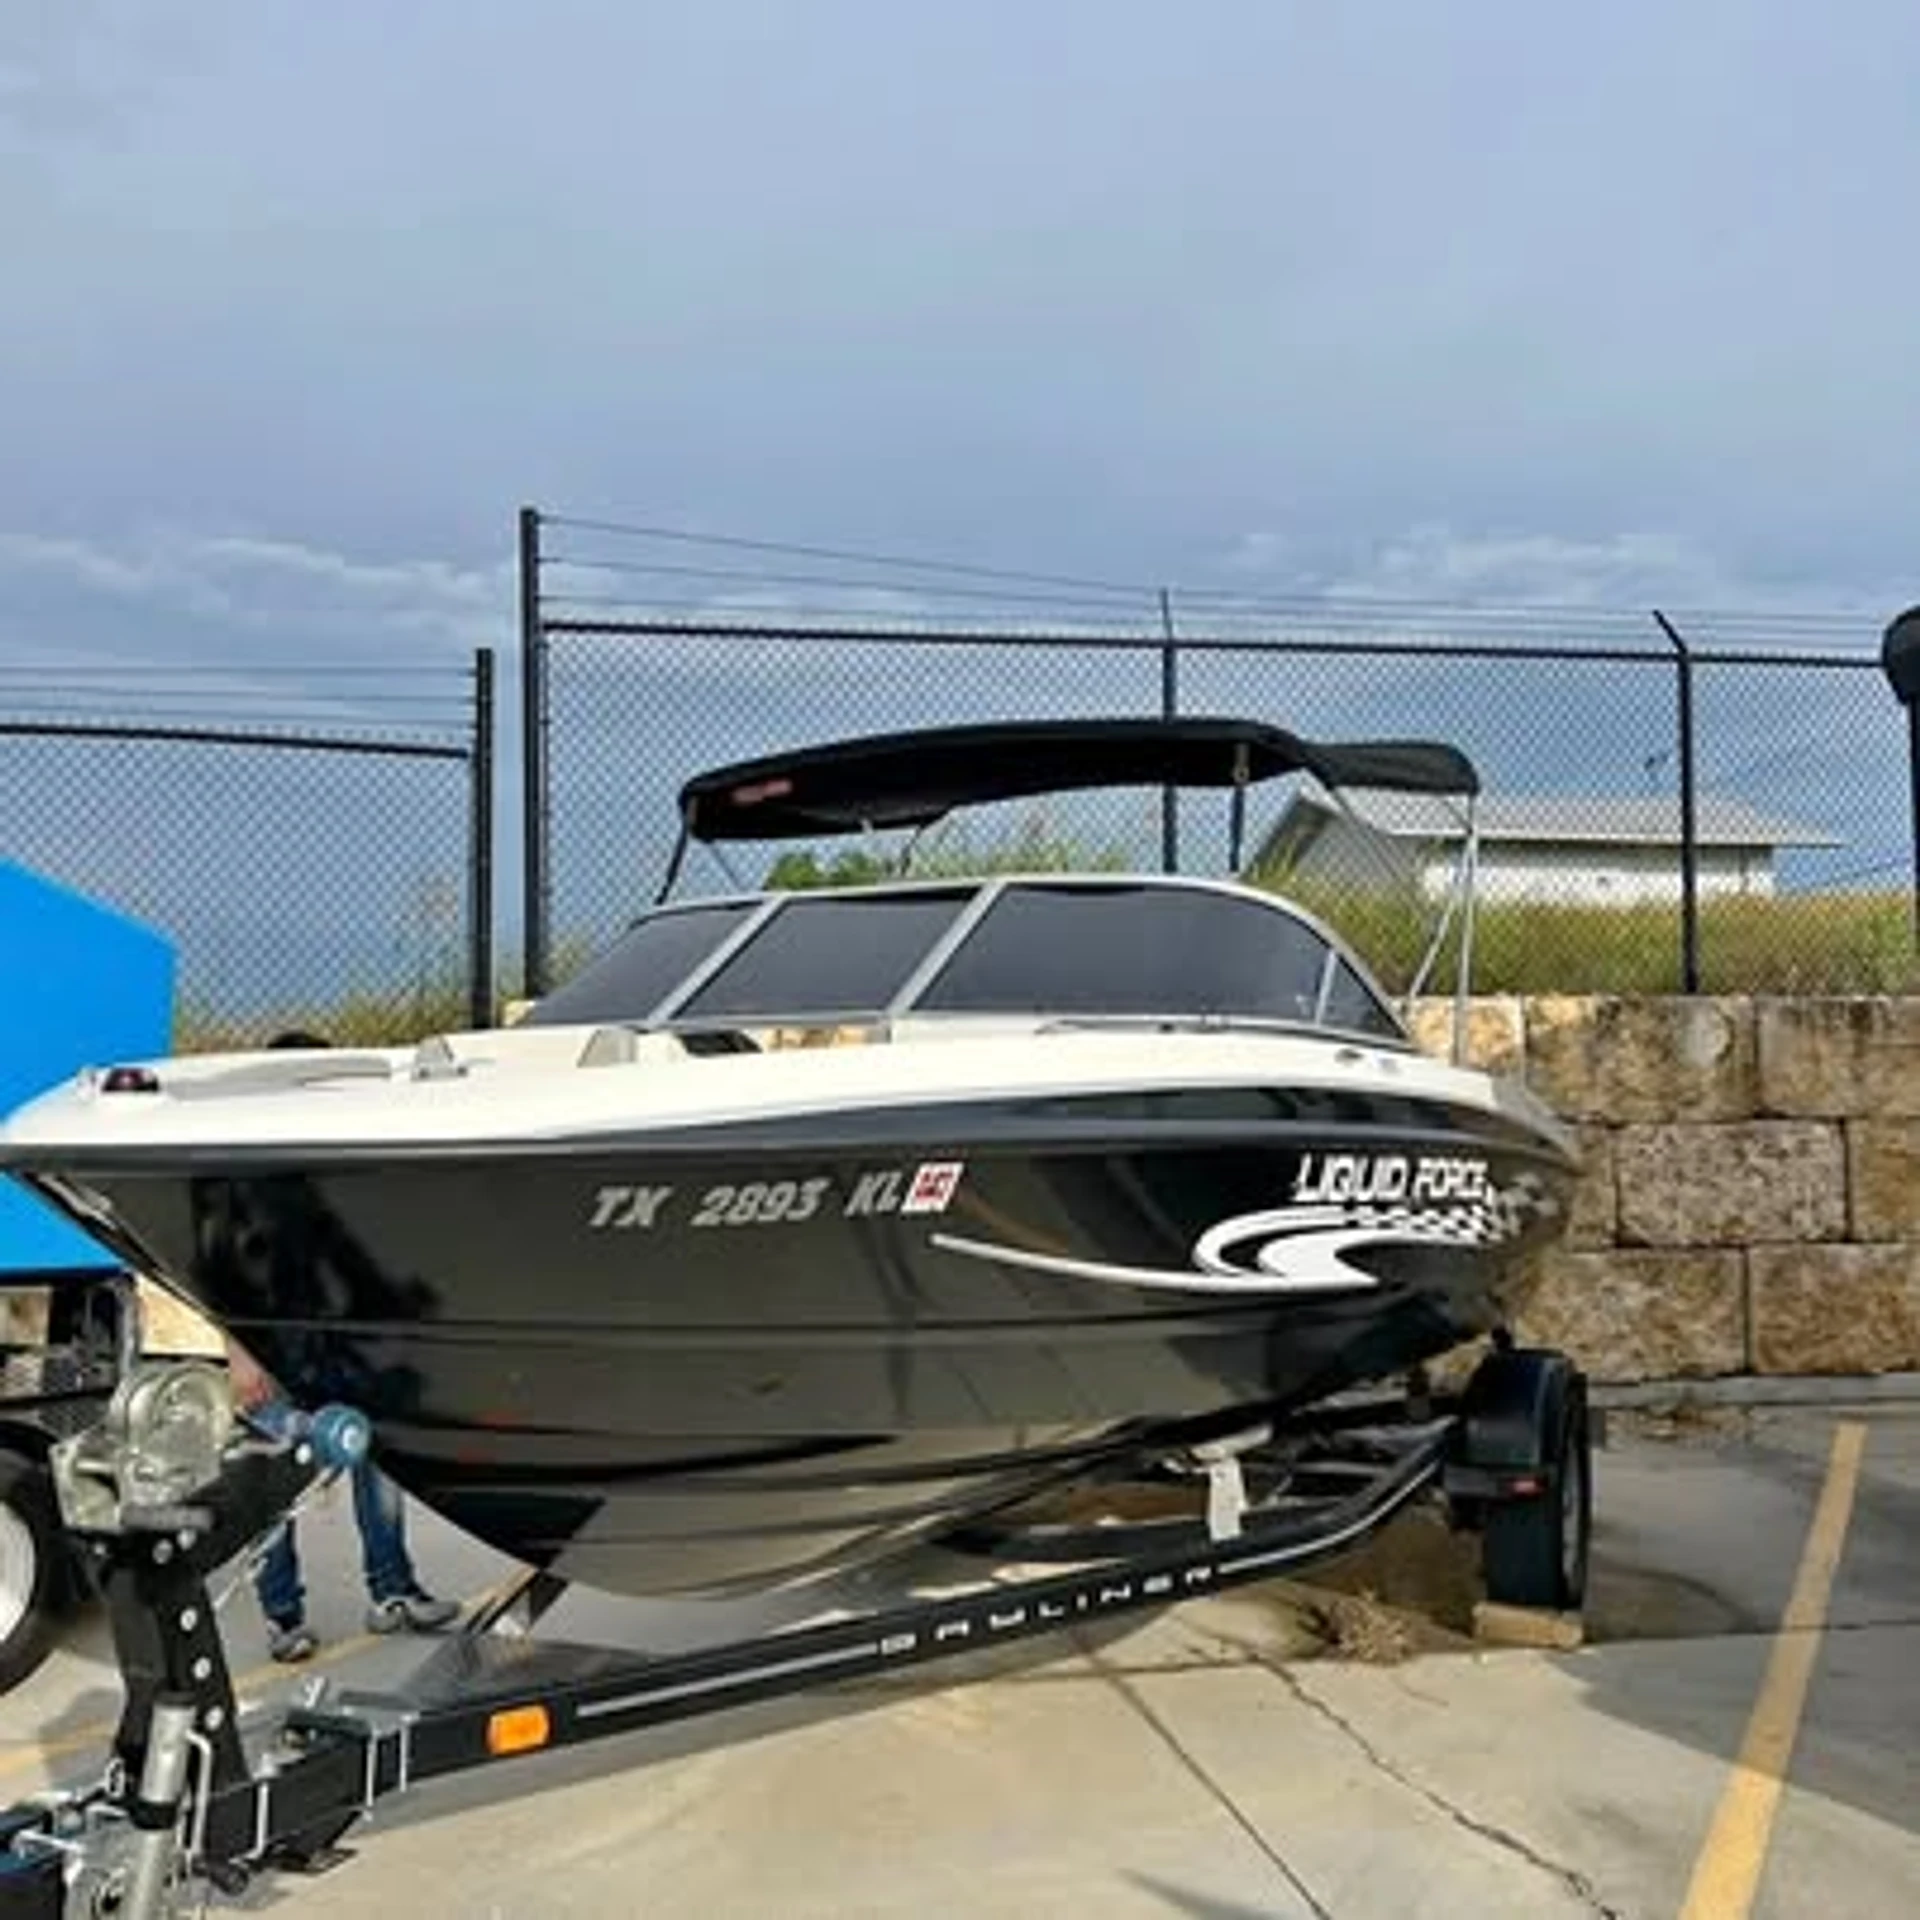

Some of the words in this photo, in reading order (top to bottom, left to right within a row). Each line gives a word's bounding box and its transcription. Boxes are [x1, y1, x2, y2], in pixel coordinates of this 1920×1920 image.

[1292, 1154, 1410, 1202] LIQUID
[1411, 1157, 1488, 1202] FORCE
[590, 1186, 673, 1228] TX
[692, 1179, 832, 1227] 2893
